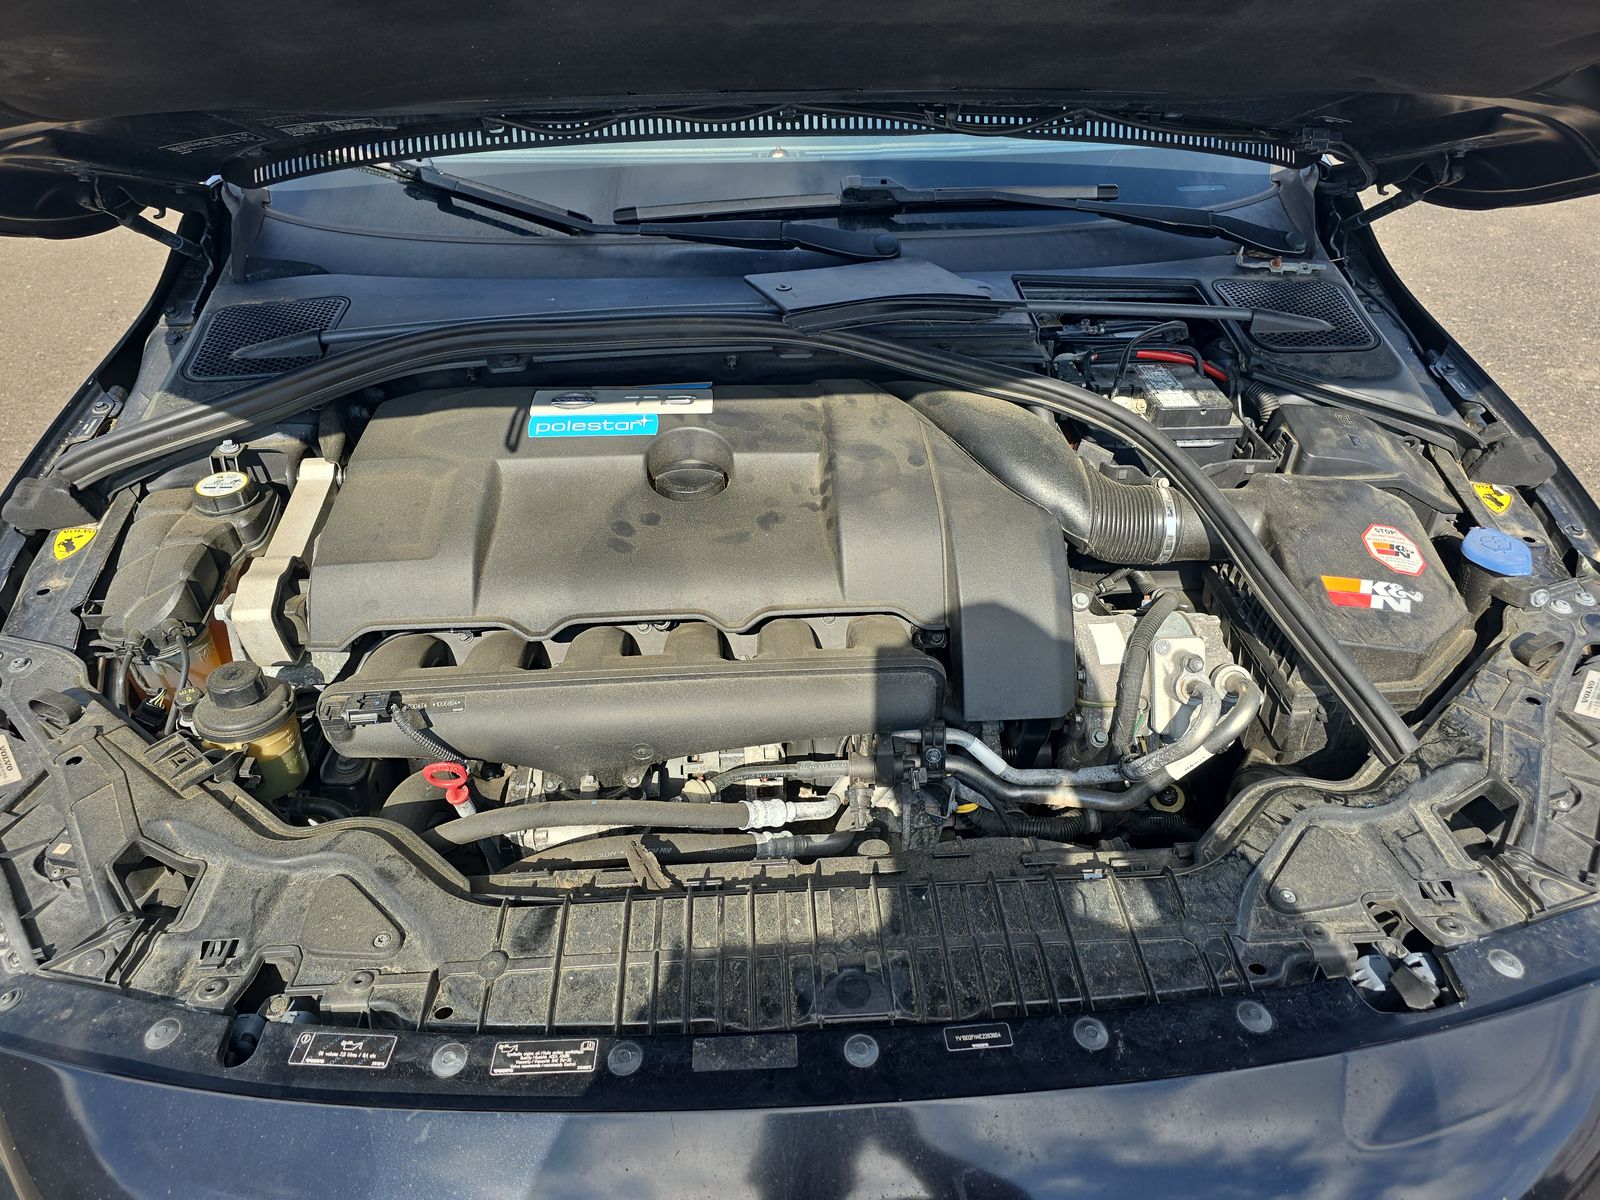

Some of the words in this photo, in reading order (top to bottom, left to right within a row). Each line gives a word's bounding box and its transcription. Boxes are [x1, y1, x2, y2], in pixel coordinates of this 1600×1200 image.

[535, 417, 646, 435] polestar
[1360, 579, 1424, 613] K&N
[1581, 680, 1595, 703] VOLVO
[0, 745, 13, 771] VOLVO
